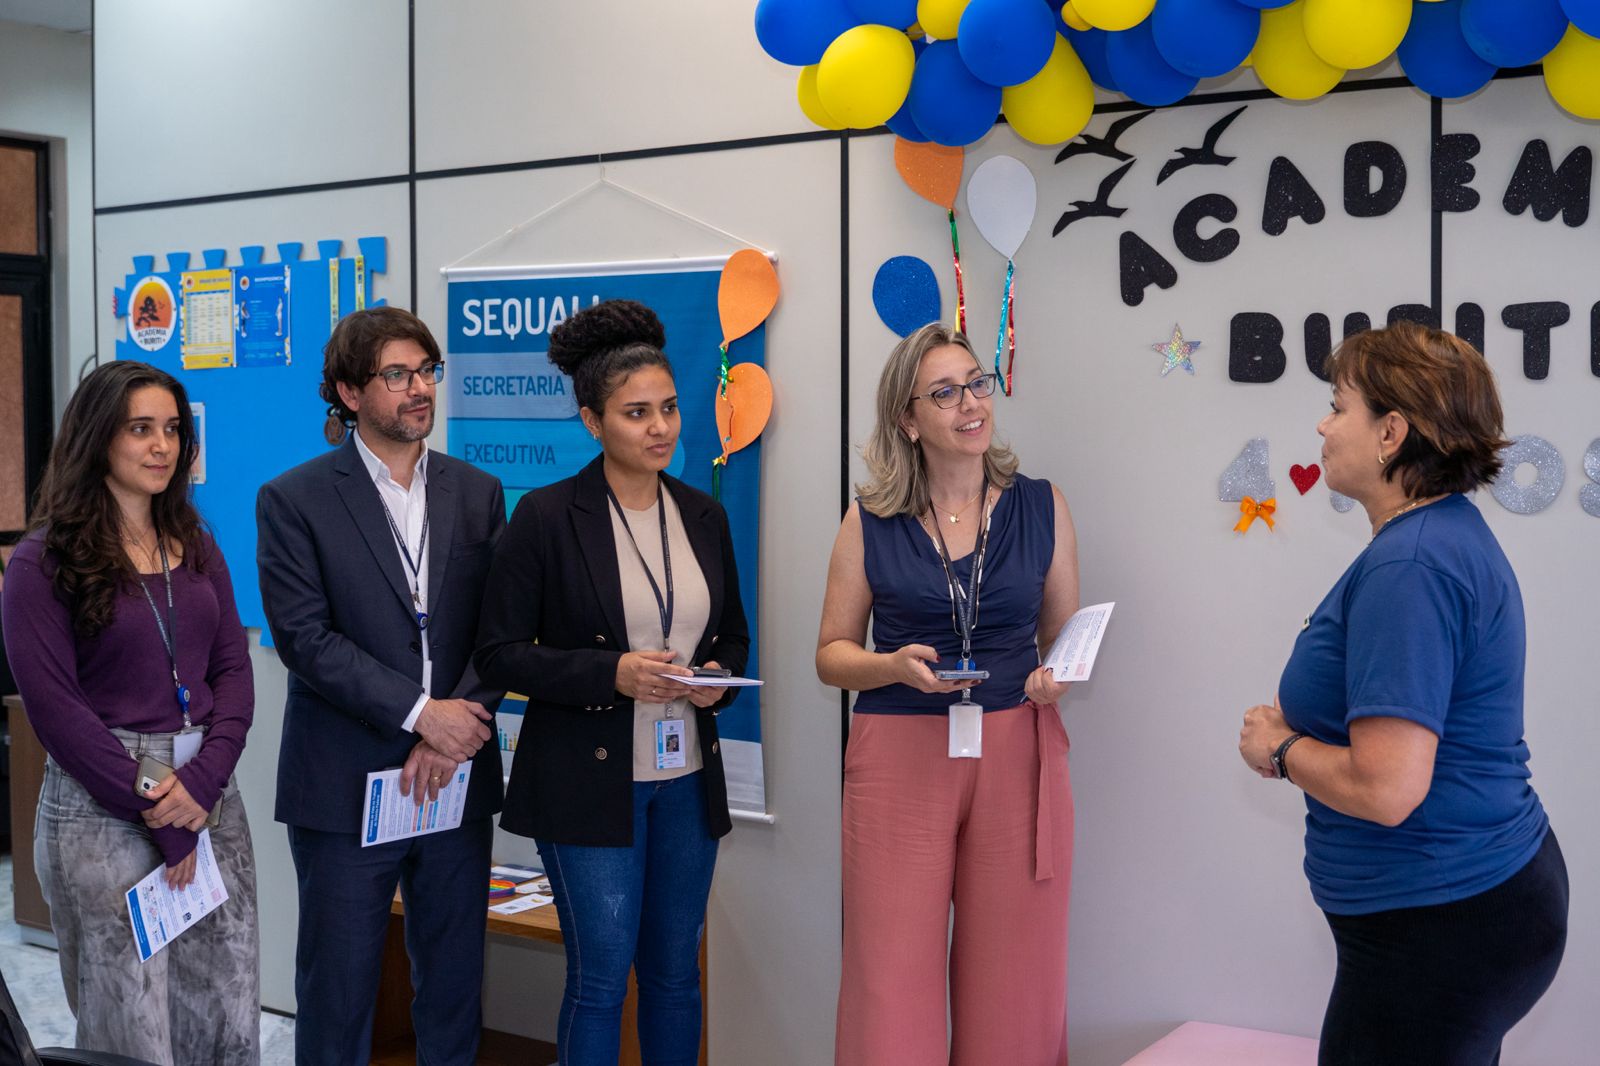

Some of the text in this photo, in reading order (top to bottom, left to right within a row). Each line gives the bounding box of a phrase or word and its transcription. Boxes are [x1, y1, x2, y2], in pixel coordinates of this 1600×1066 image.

[462, 294, 600, 341] SEQUA
[1228, 300, 1600, 383] BUIT
[463, 375, 565, 396] SECRETARIA
[464, 443, 556, 465] EXECUTIVA
[1218, 437, 1276, 503] 4
